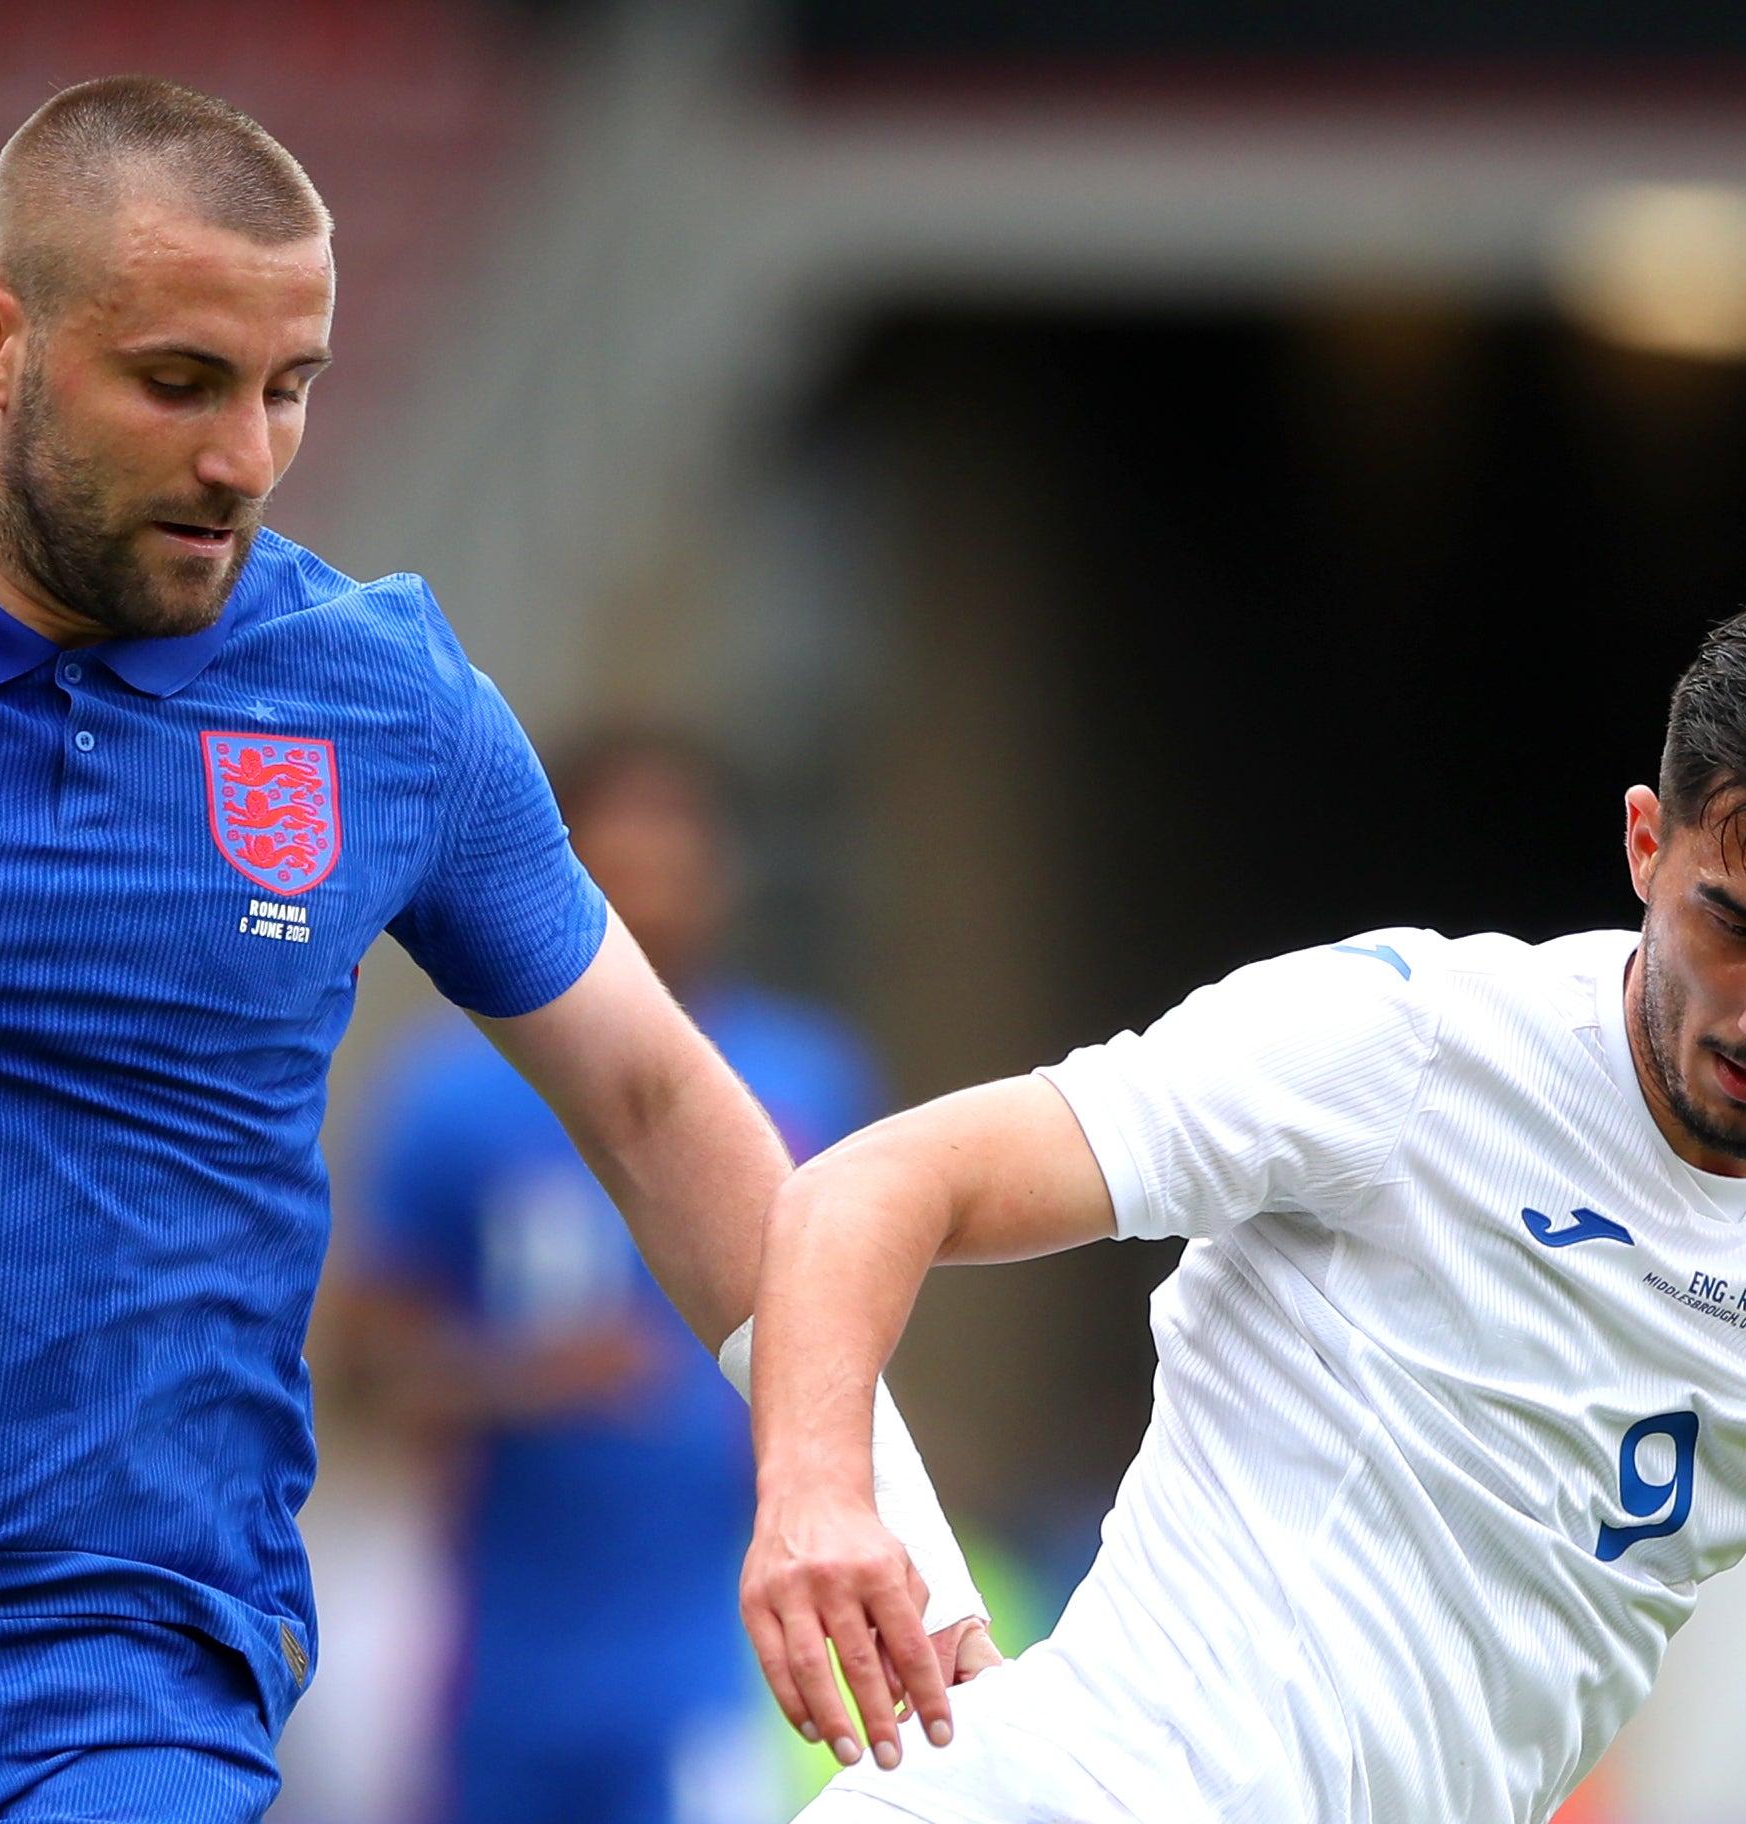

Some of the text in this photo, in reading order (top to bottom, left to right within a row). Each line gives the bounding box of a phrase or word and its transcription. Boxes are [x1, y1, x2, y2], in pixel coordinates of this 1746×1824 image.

[249, 899, 307, 924] ROMANIA
[239, 917, 311, 944] 6 JUNE 2021
[1642, 1271, 1740, 1327] MIDDLESBROUGH,
[1688, 1270, 1729, 1304] ENG
[1595, 1411, 1700, 1563] 9
